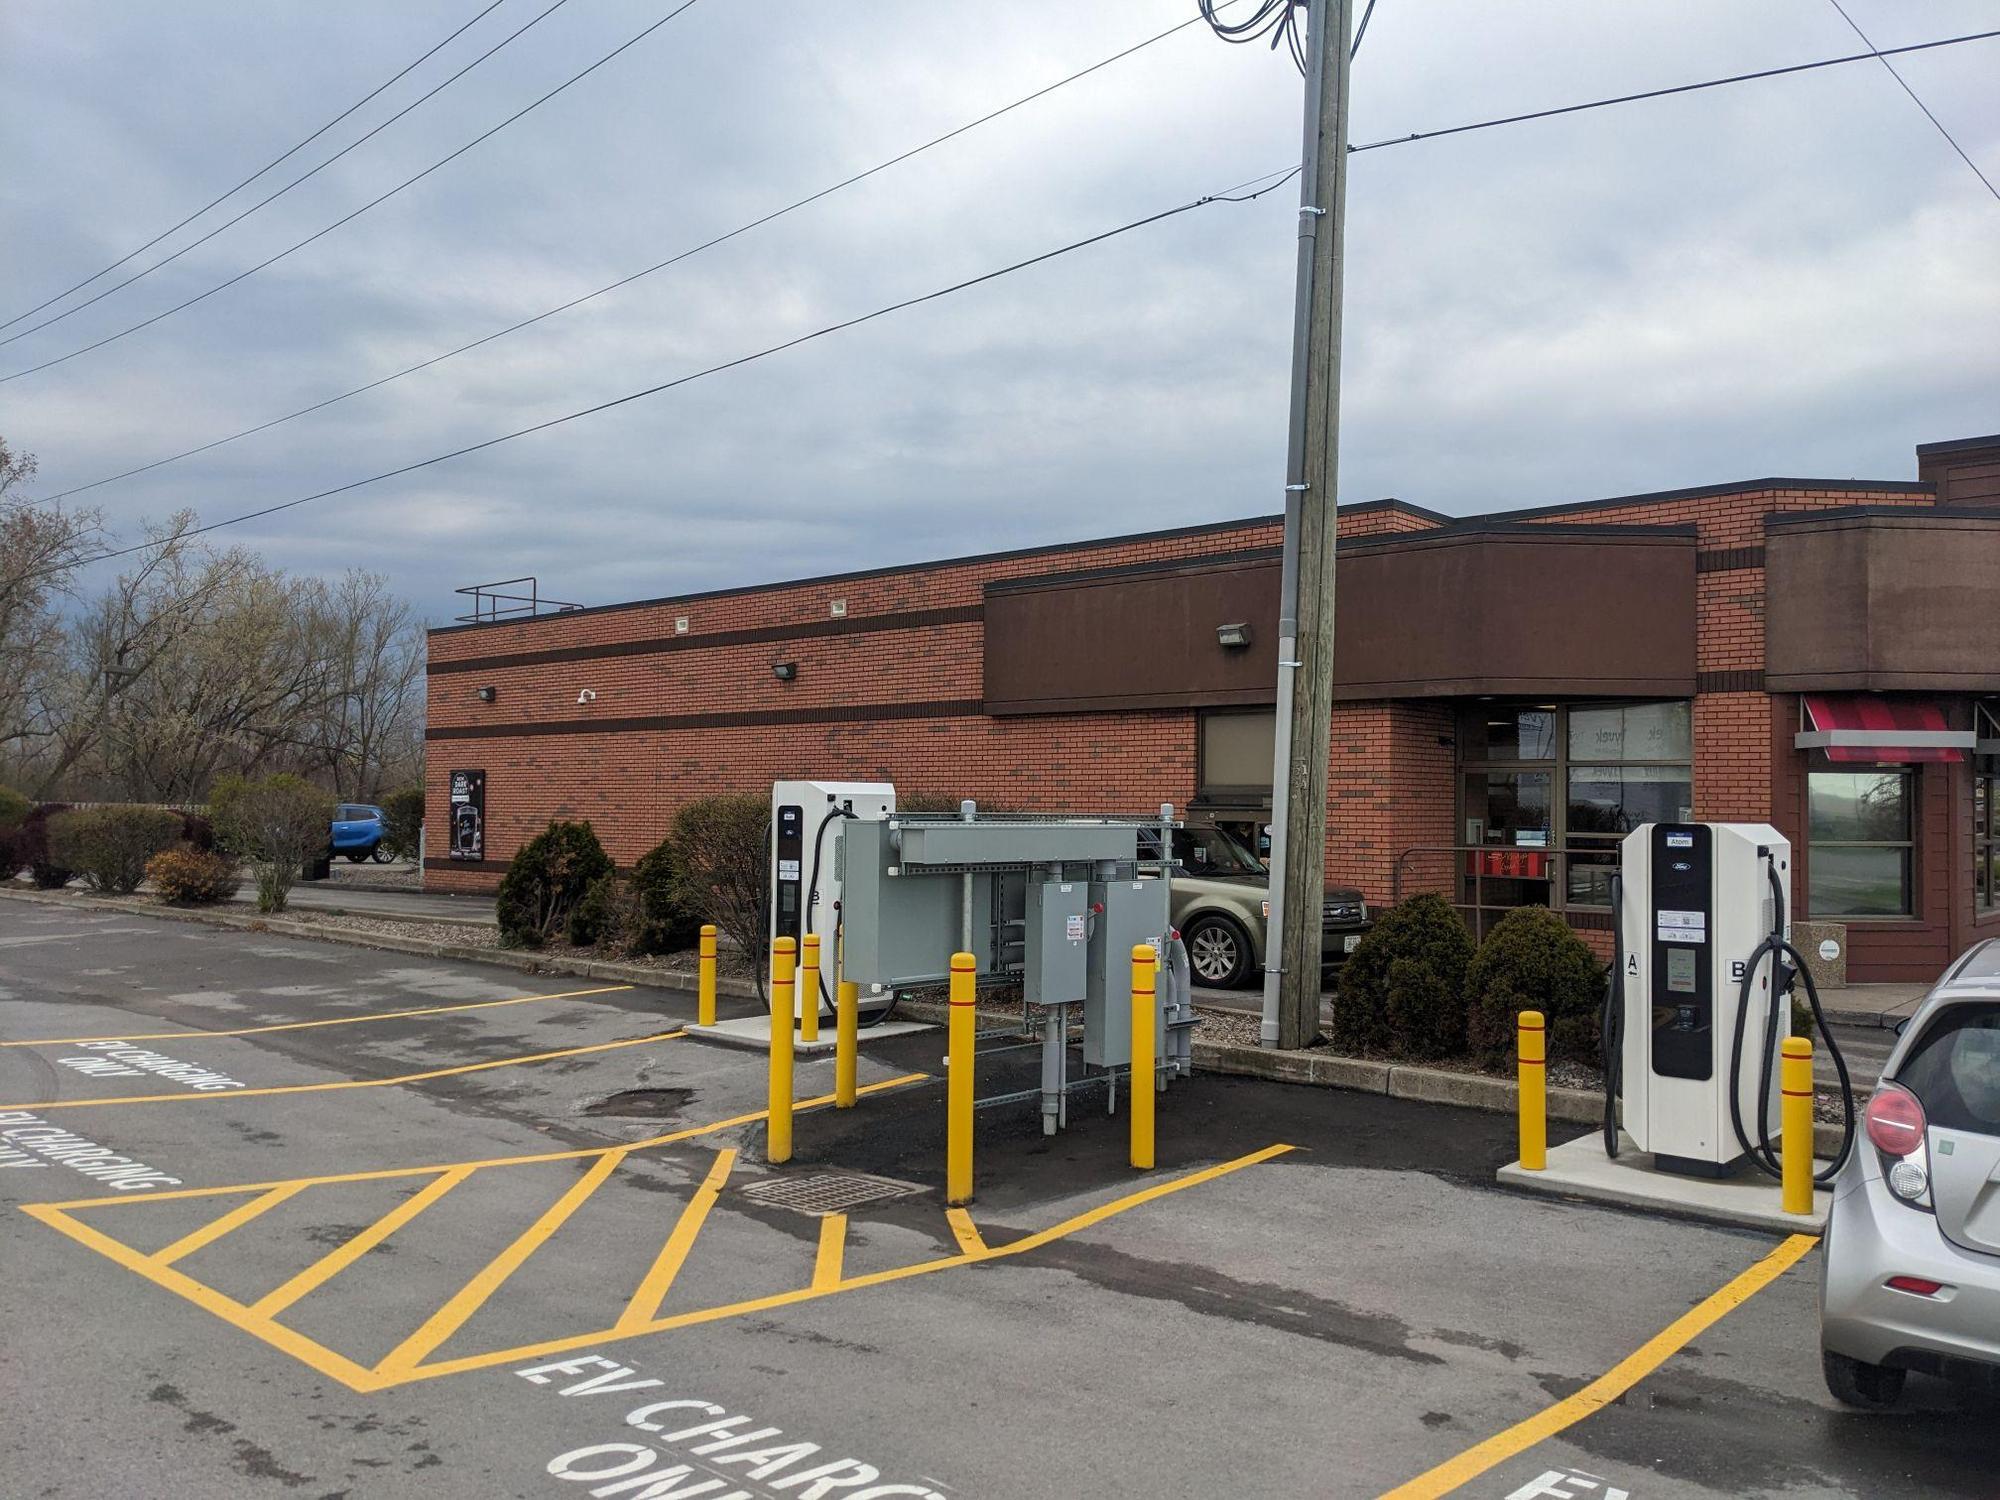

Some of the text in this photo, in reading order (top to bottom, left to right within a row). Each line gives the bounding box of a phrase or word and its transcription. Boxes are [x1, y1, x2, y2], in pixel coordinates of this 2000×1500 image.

[1628, 954, 1638, 969] A
[1732, 962, 1746, 977] B
[57, 1057, 146, 1076] ONLY
[76, 1041, 245, 1090] EV CHARGING
[2, 1128, 182, 1190] CHARGING
[514, 1355, 665, 1396] EV
[547, 1443, 753, 1500] ON
[1504, 1470, 1629, 1500] E
